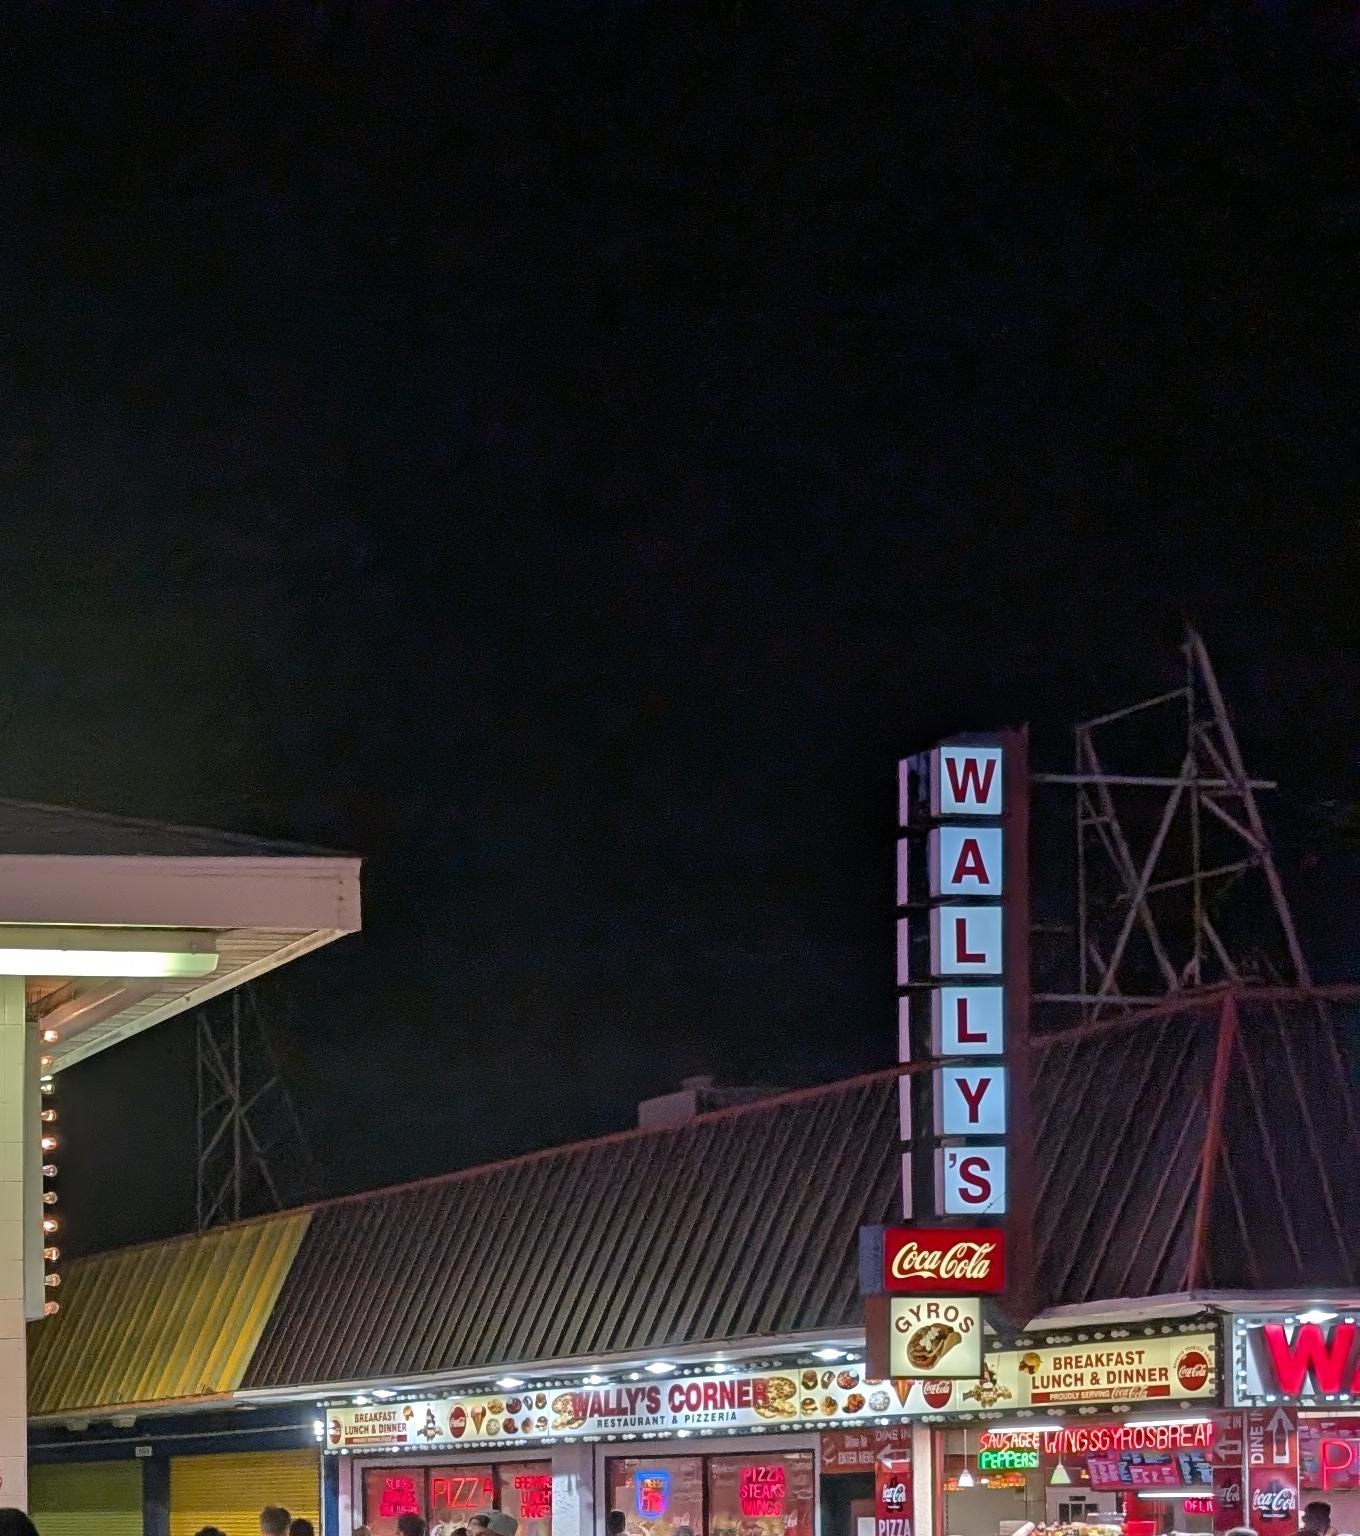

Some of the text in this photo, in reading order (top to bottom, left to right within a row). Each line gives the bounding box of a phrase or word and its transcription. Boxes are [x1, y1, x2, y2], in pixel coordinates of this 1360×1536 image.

[945, 757, 997, 1205] WALLY'S
[894, 1302, 975, 1334] GYROS
[1053, 1350, 1146, 1371] BREAKFAST
[1032, 1367, 1169, 1390] LUNCH & DINNER
[571, 1377, 769, 1421] WALLY'S CORNER
[1049, 1391, 1080, 1401] PROUDLY
[1081, 1390, 1110, 1400] SERVING
[354, 1411, 397, 1424] BREAKFAST
[596, 1411, 738, 1429] RESTAURANT & PIZZERIA
[344, 1422, 408, 1436] LUNCH & DINNER
[1044, 1426, 1099, 1454] WINGS
[1099, 1427, 1157, 1451] GYROS
[1250, 1426, 1264, 1464] DINE
[980, 1450, 1038, 1469] PEPPERS
[742, 1466, 786, 1483] PIZZA
[432, 1477, 494, 1510] PIZZA
[741, 1483, 786, 1499] STEAKS
[742, 1500, 783, 1516] WINGS
